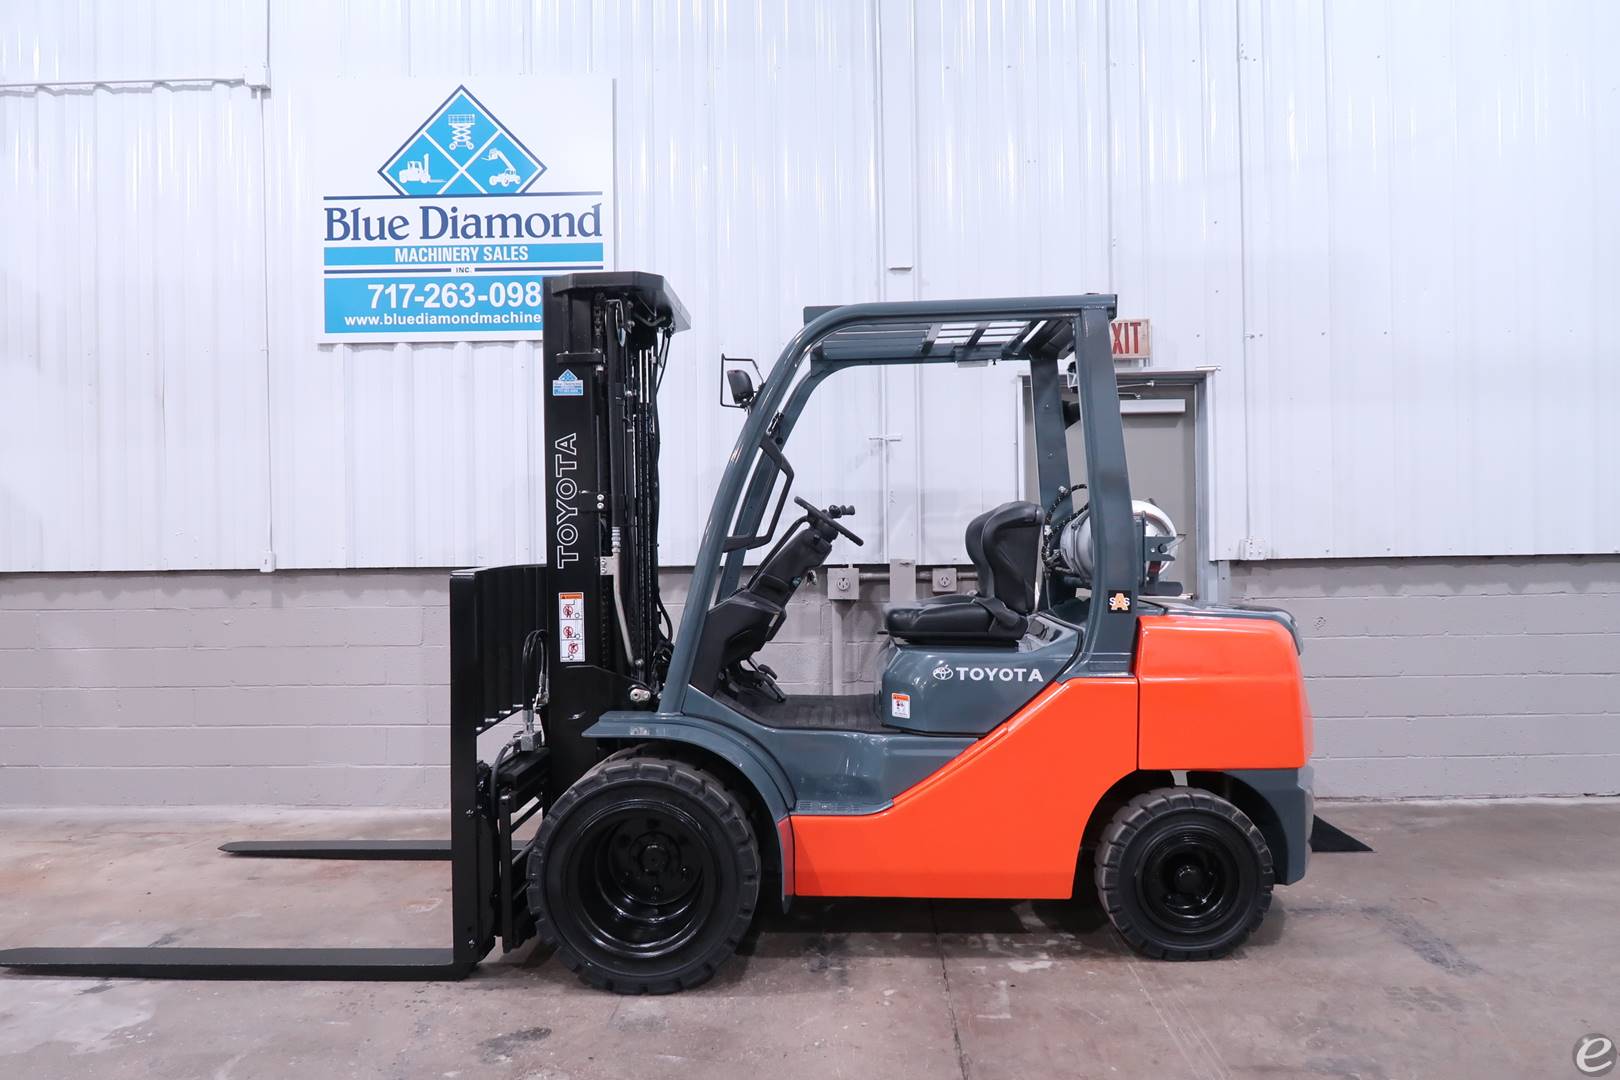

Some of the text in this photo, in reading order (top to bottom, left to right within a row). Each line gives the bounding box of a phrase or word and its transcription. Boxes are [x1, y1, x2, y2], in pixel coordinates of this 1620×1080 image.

[324, 202, 603, 242] Blue Diamond
[394, 245, 529, 264] MACHINERY SALES
[367, 281, 542, 309] 717-263-098
[344, 311, 542, 327] www.bluediamondmachine
[1111, 321, 1142, 355] XIT
[554, 432, 580, 570] TOYOTA
[955, 666, 1044, 683] TOYOTA
